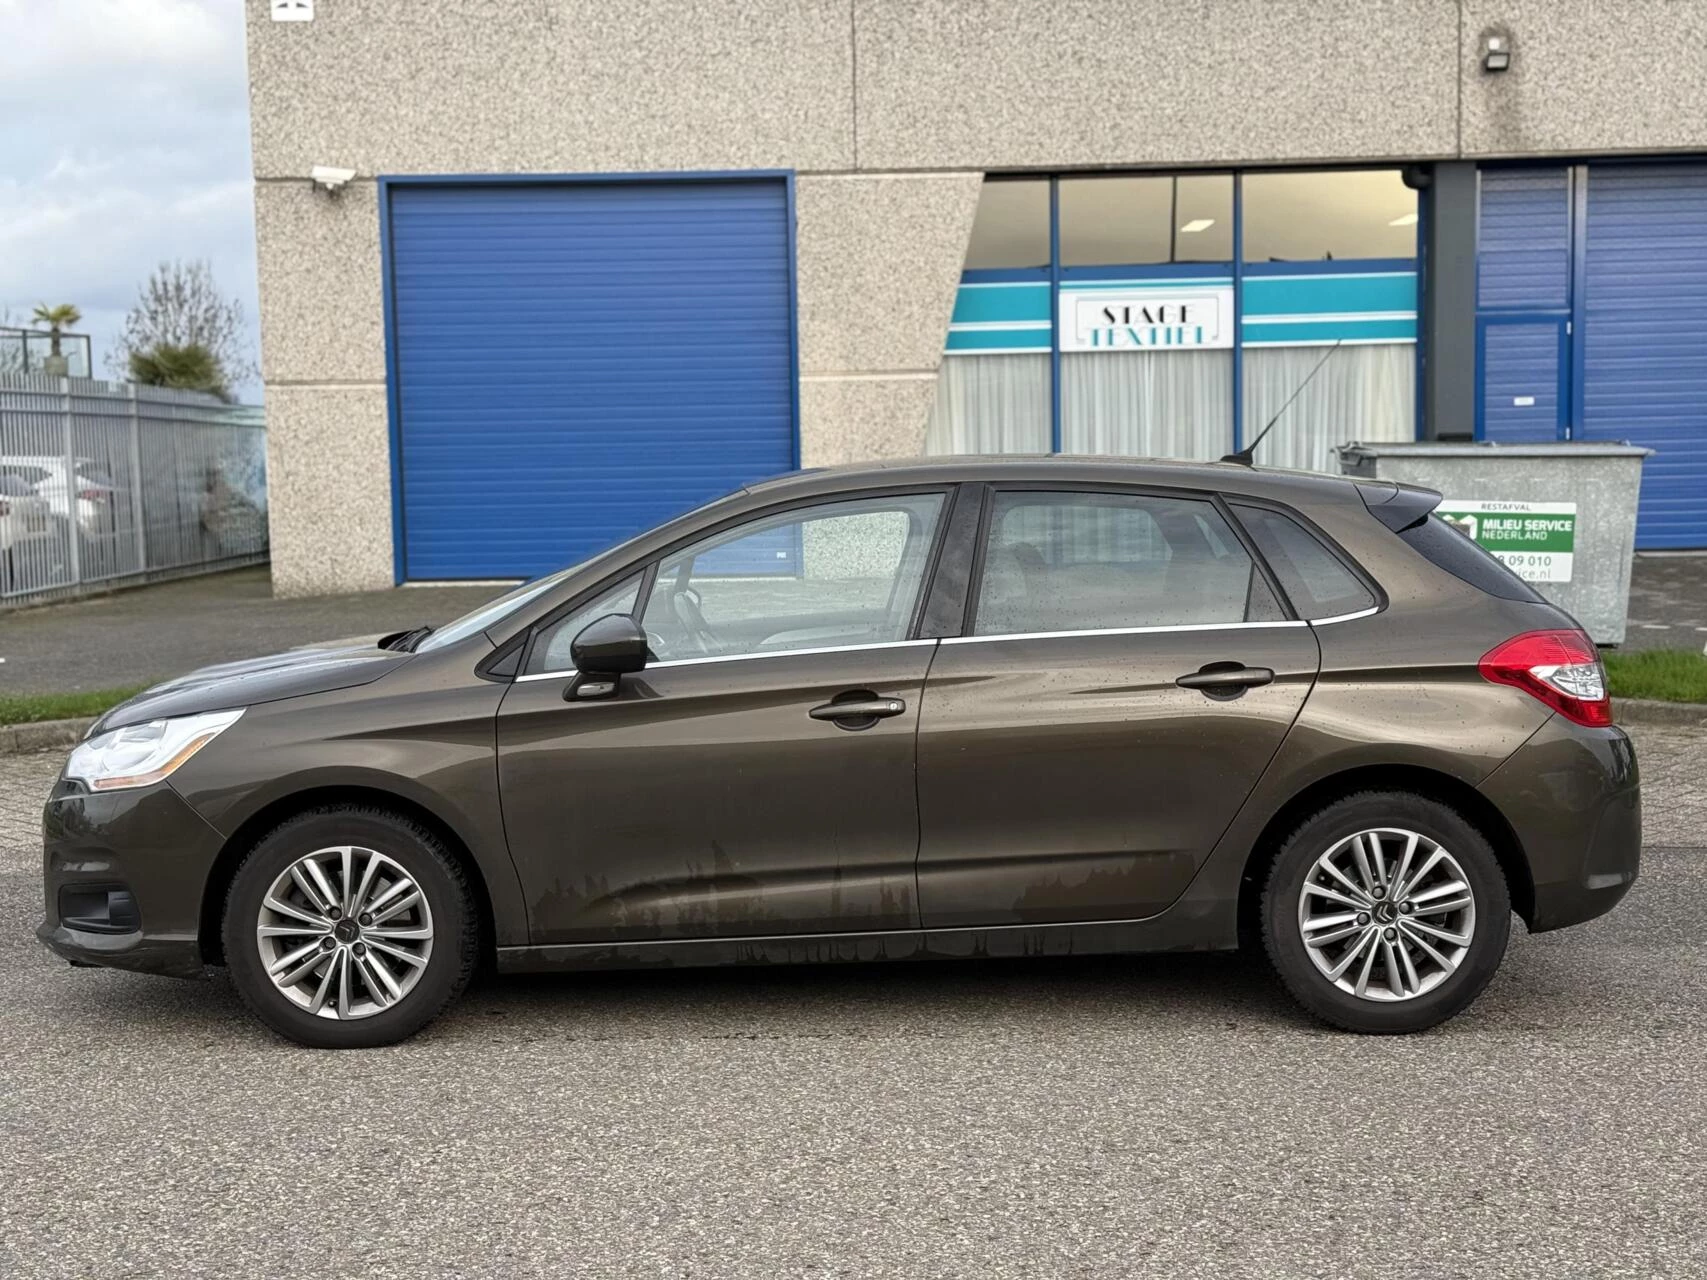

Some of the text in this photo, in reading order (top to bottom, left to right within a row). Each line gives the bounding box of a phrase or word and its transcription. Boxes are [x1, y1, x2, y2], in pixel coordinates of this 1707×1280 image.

[1102, 304, 1194, 325] STAGE
[1087, 326, 1208, 347] TEXTIEL
[1481, 503, 1531, 511] RESTAFVAL
[1482, 518, 1573, 532] MILIEU SERVICE
[1481, 530, 1548, 541] NEDERLAND
[1508, 555, 1525, 566] 09
[1527, 556, 1552, 567] 010
